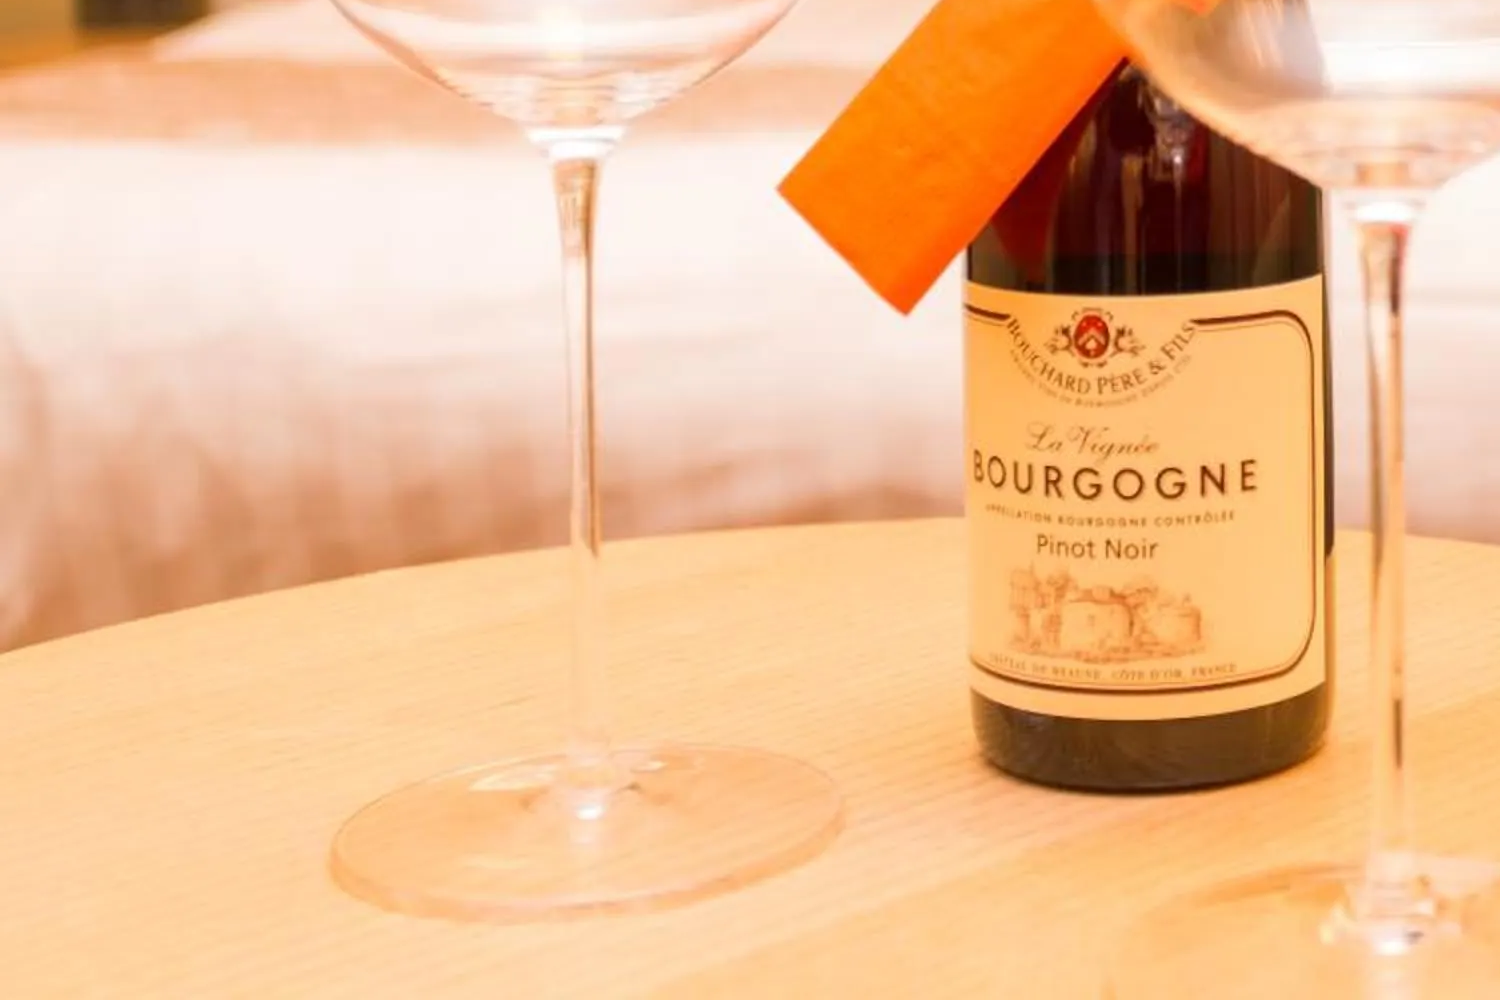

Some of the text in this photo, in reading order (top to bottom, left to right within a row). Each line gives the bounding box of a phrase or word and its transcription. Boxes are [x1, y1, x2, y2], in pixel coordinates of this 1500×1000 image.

[1006, 317, 1091, 395] BOUCHARD
[1097, 368, 1147, 396] PÈRE
[1148, 359, 1166, 376] &
[1160, 320, 1199, 362] FILS
[1024, 421, 1160, 465] La Vignée
[973, 449, 1259, 502] BOURGOGNE
[1057, 516, 1147, 529] BOURGOGNE
[1036, 534, 1159, 561] Pinot Noir
